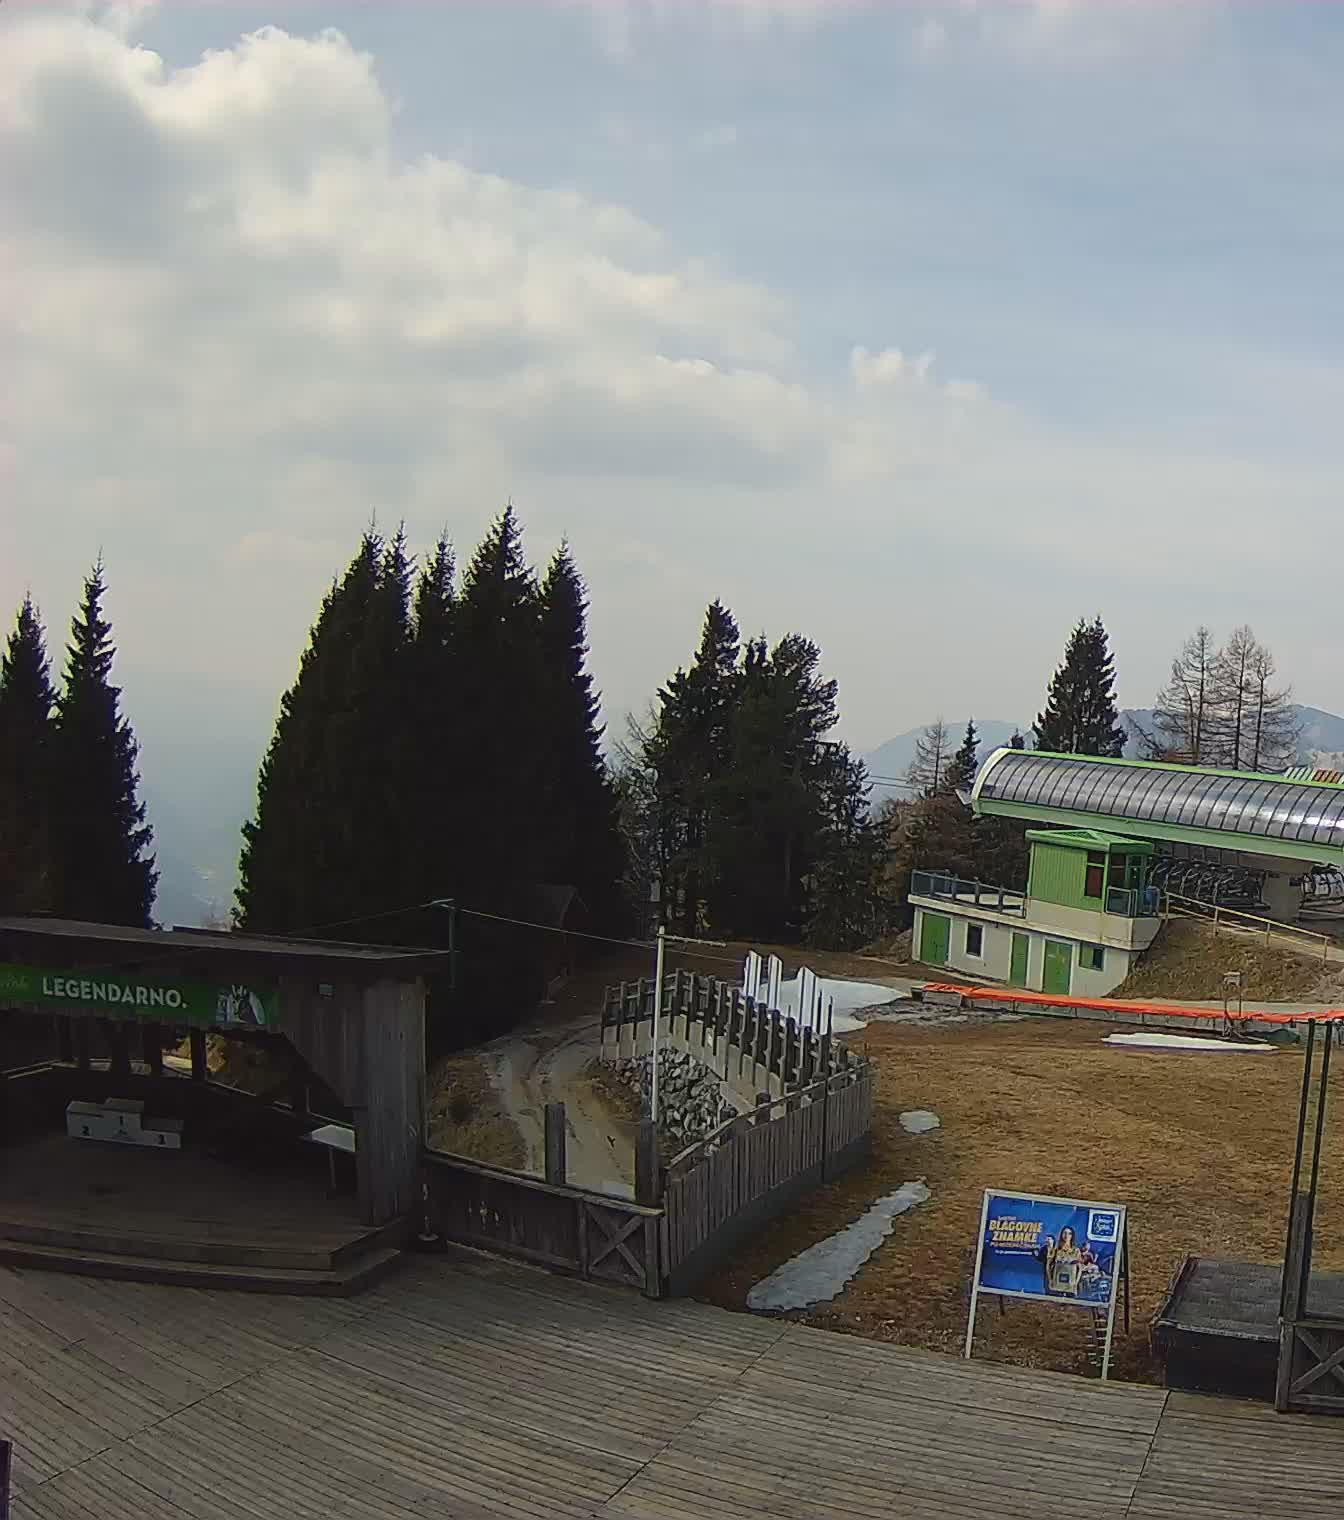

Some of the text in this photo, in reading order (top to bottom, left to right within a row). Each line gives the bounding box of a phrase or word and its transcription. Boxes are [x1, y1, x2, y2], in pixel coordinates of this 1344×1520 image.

[42, 976, 188, 1008] LEGENDARNO.
[989, 1220, 1042, 1232] BLAGOVNE
[992, 1231, 1037, 1243] ZNAMKE
